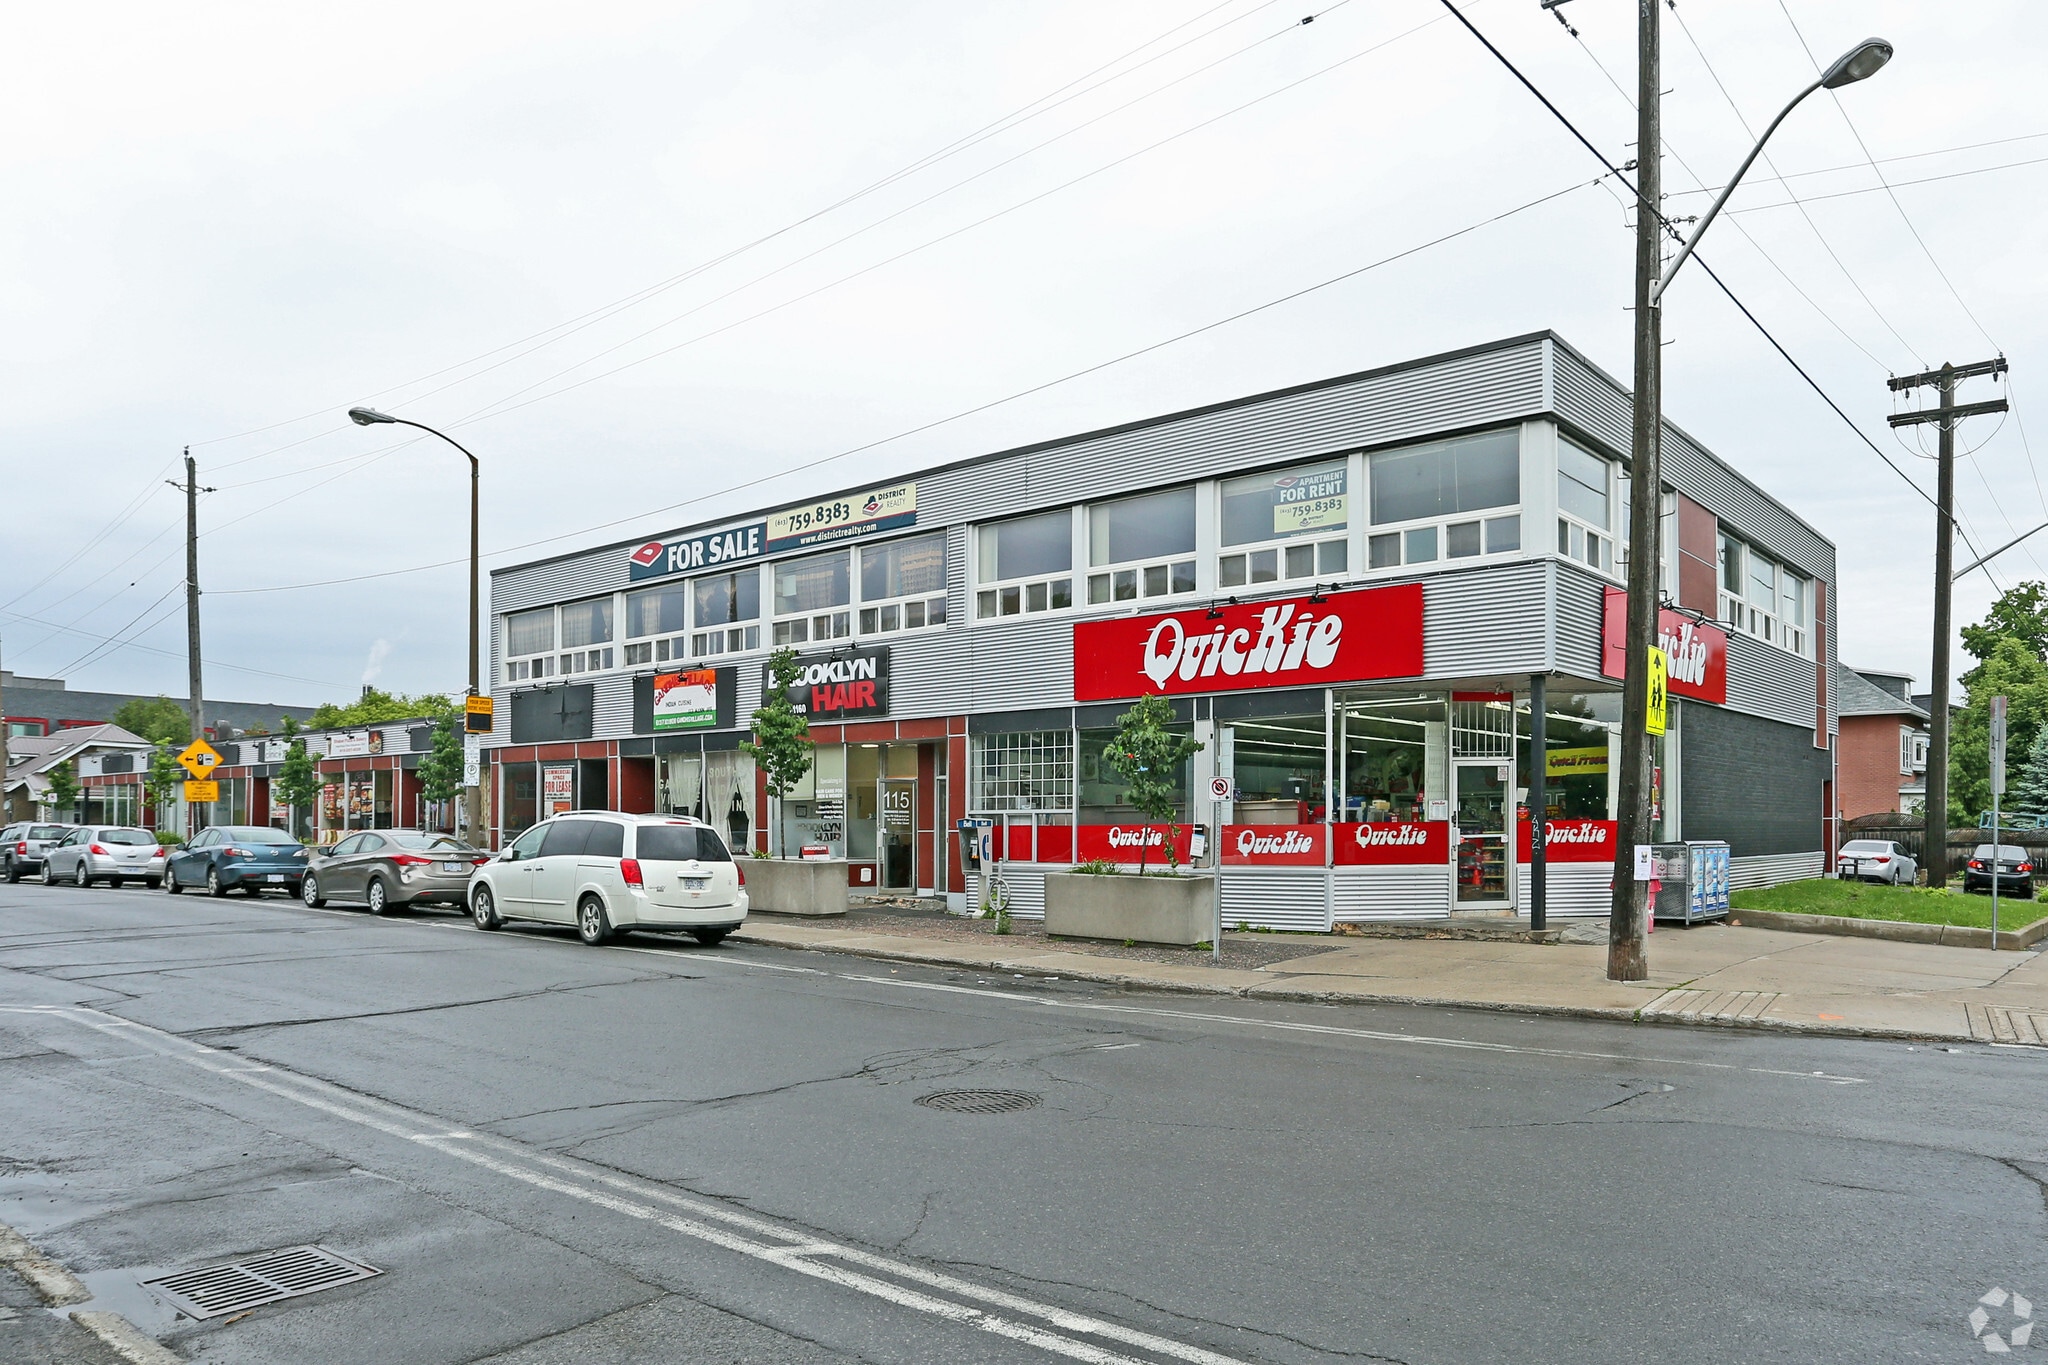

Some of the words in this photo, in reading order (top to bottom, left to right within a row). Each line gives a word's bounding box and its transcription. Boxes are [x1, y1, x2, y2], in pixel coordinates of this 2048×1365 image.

[1299, 470, 1344, 486] APARTMENT
[878, 488, 906, 500] DISTRICT
[1280, 486, 1306, 503] FOR
[1309, 480, 1342, 498] RENT
[886, 498, 906, 508] REALTY
[1292, 499, 1342, 517] 759.8383
[789, 502, 850, 532] 759.8383
[800, 522, 877, 545] www.districtrealty.com
[668, 540, 704, 572] FOR
[709, 527, 759, 563] SALE
[812, 680, 877, 712] HAIR
[545, 781, 555, 792] FOR
[556, 780, 571, 793] LEASE
[884, 791, 909, 808] 115
[815, 832, 842, 842] HAIR
